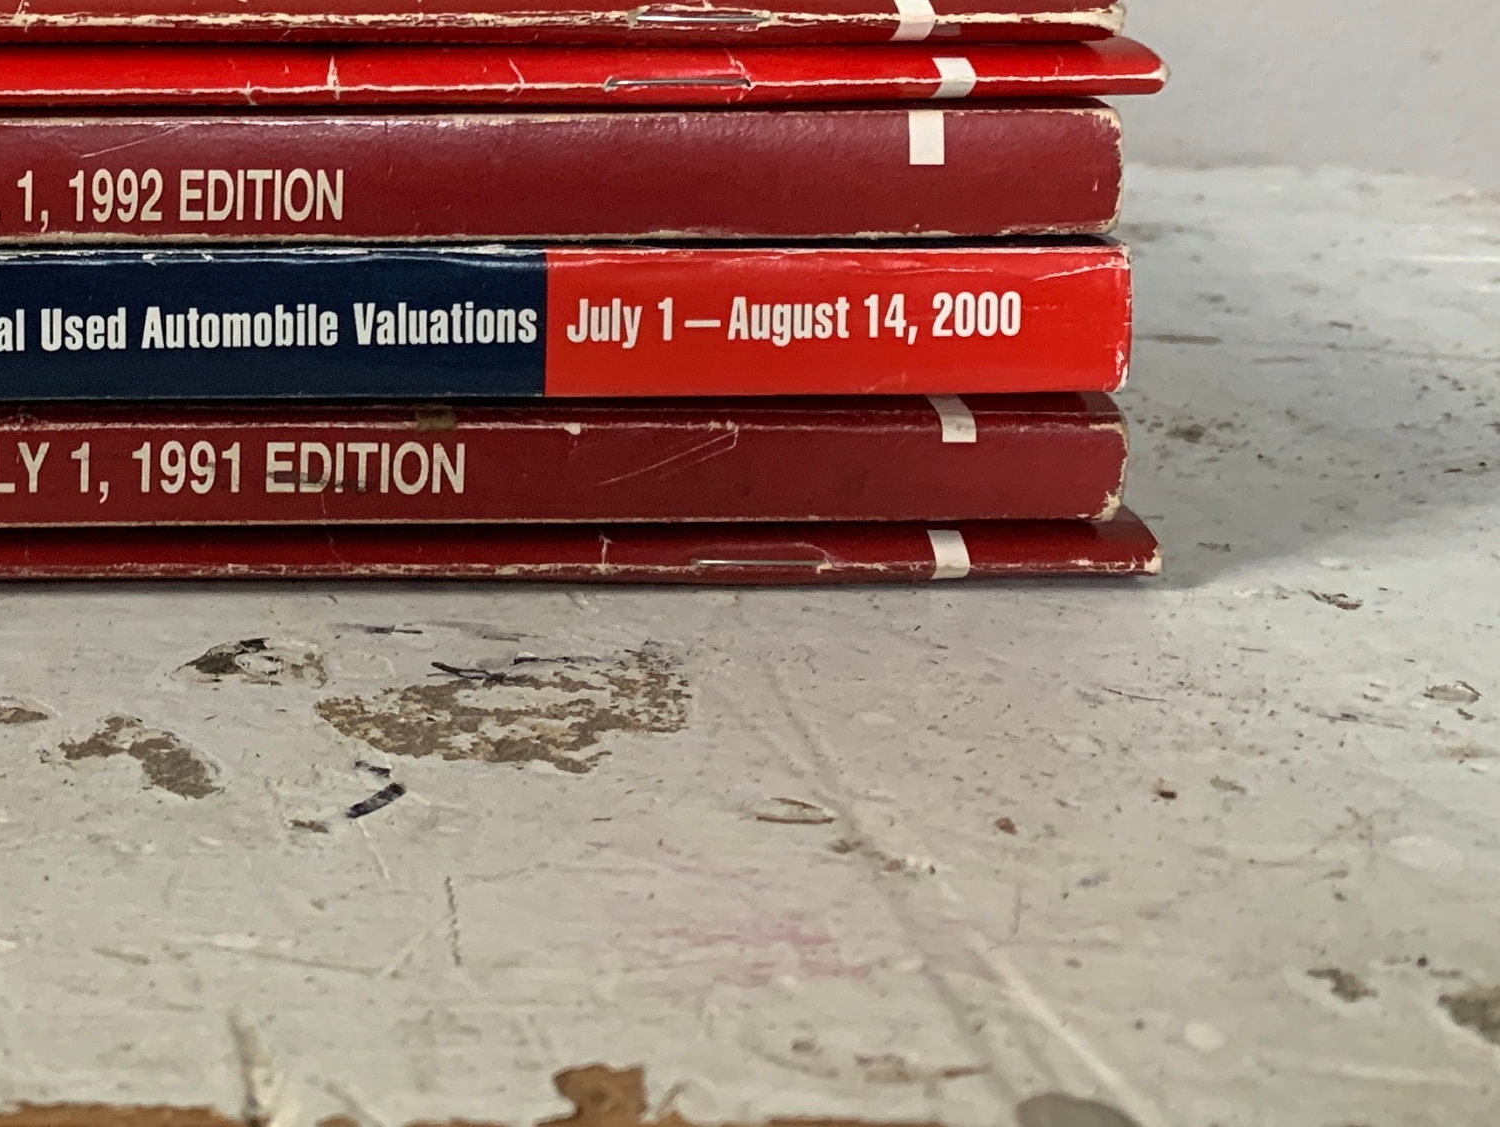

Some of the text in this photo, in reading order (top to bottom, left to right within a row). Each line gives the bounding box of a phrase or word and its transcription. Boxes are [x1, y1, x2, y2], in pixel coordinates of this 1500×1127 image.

[16, 169, 51, 235] 1,
[67, 168, 164, 223] 1992
[178, 167, 345, 223] EDITION
[39, 305, 128, 353] Used
[140, 302, 339, 350] Automobile
[352, 300, 538, 346] Valuations
[566, 297, 643, 349] July
[863, 292, 919, 346] 14,
[931, 290, 1022, 338] 2000
[70, 441, 110, 503] 1,
[131, 439, 241, 495] 1991
[265, 440, 466, 496] EDITION
